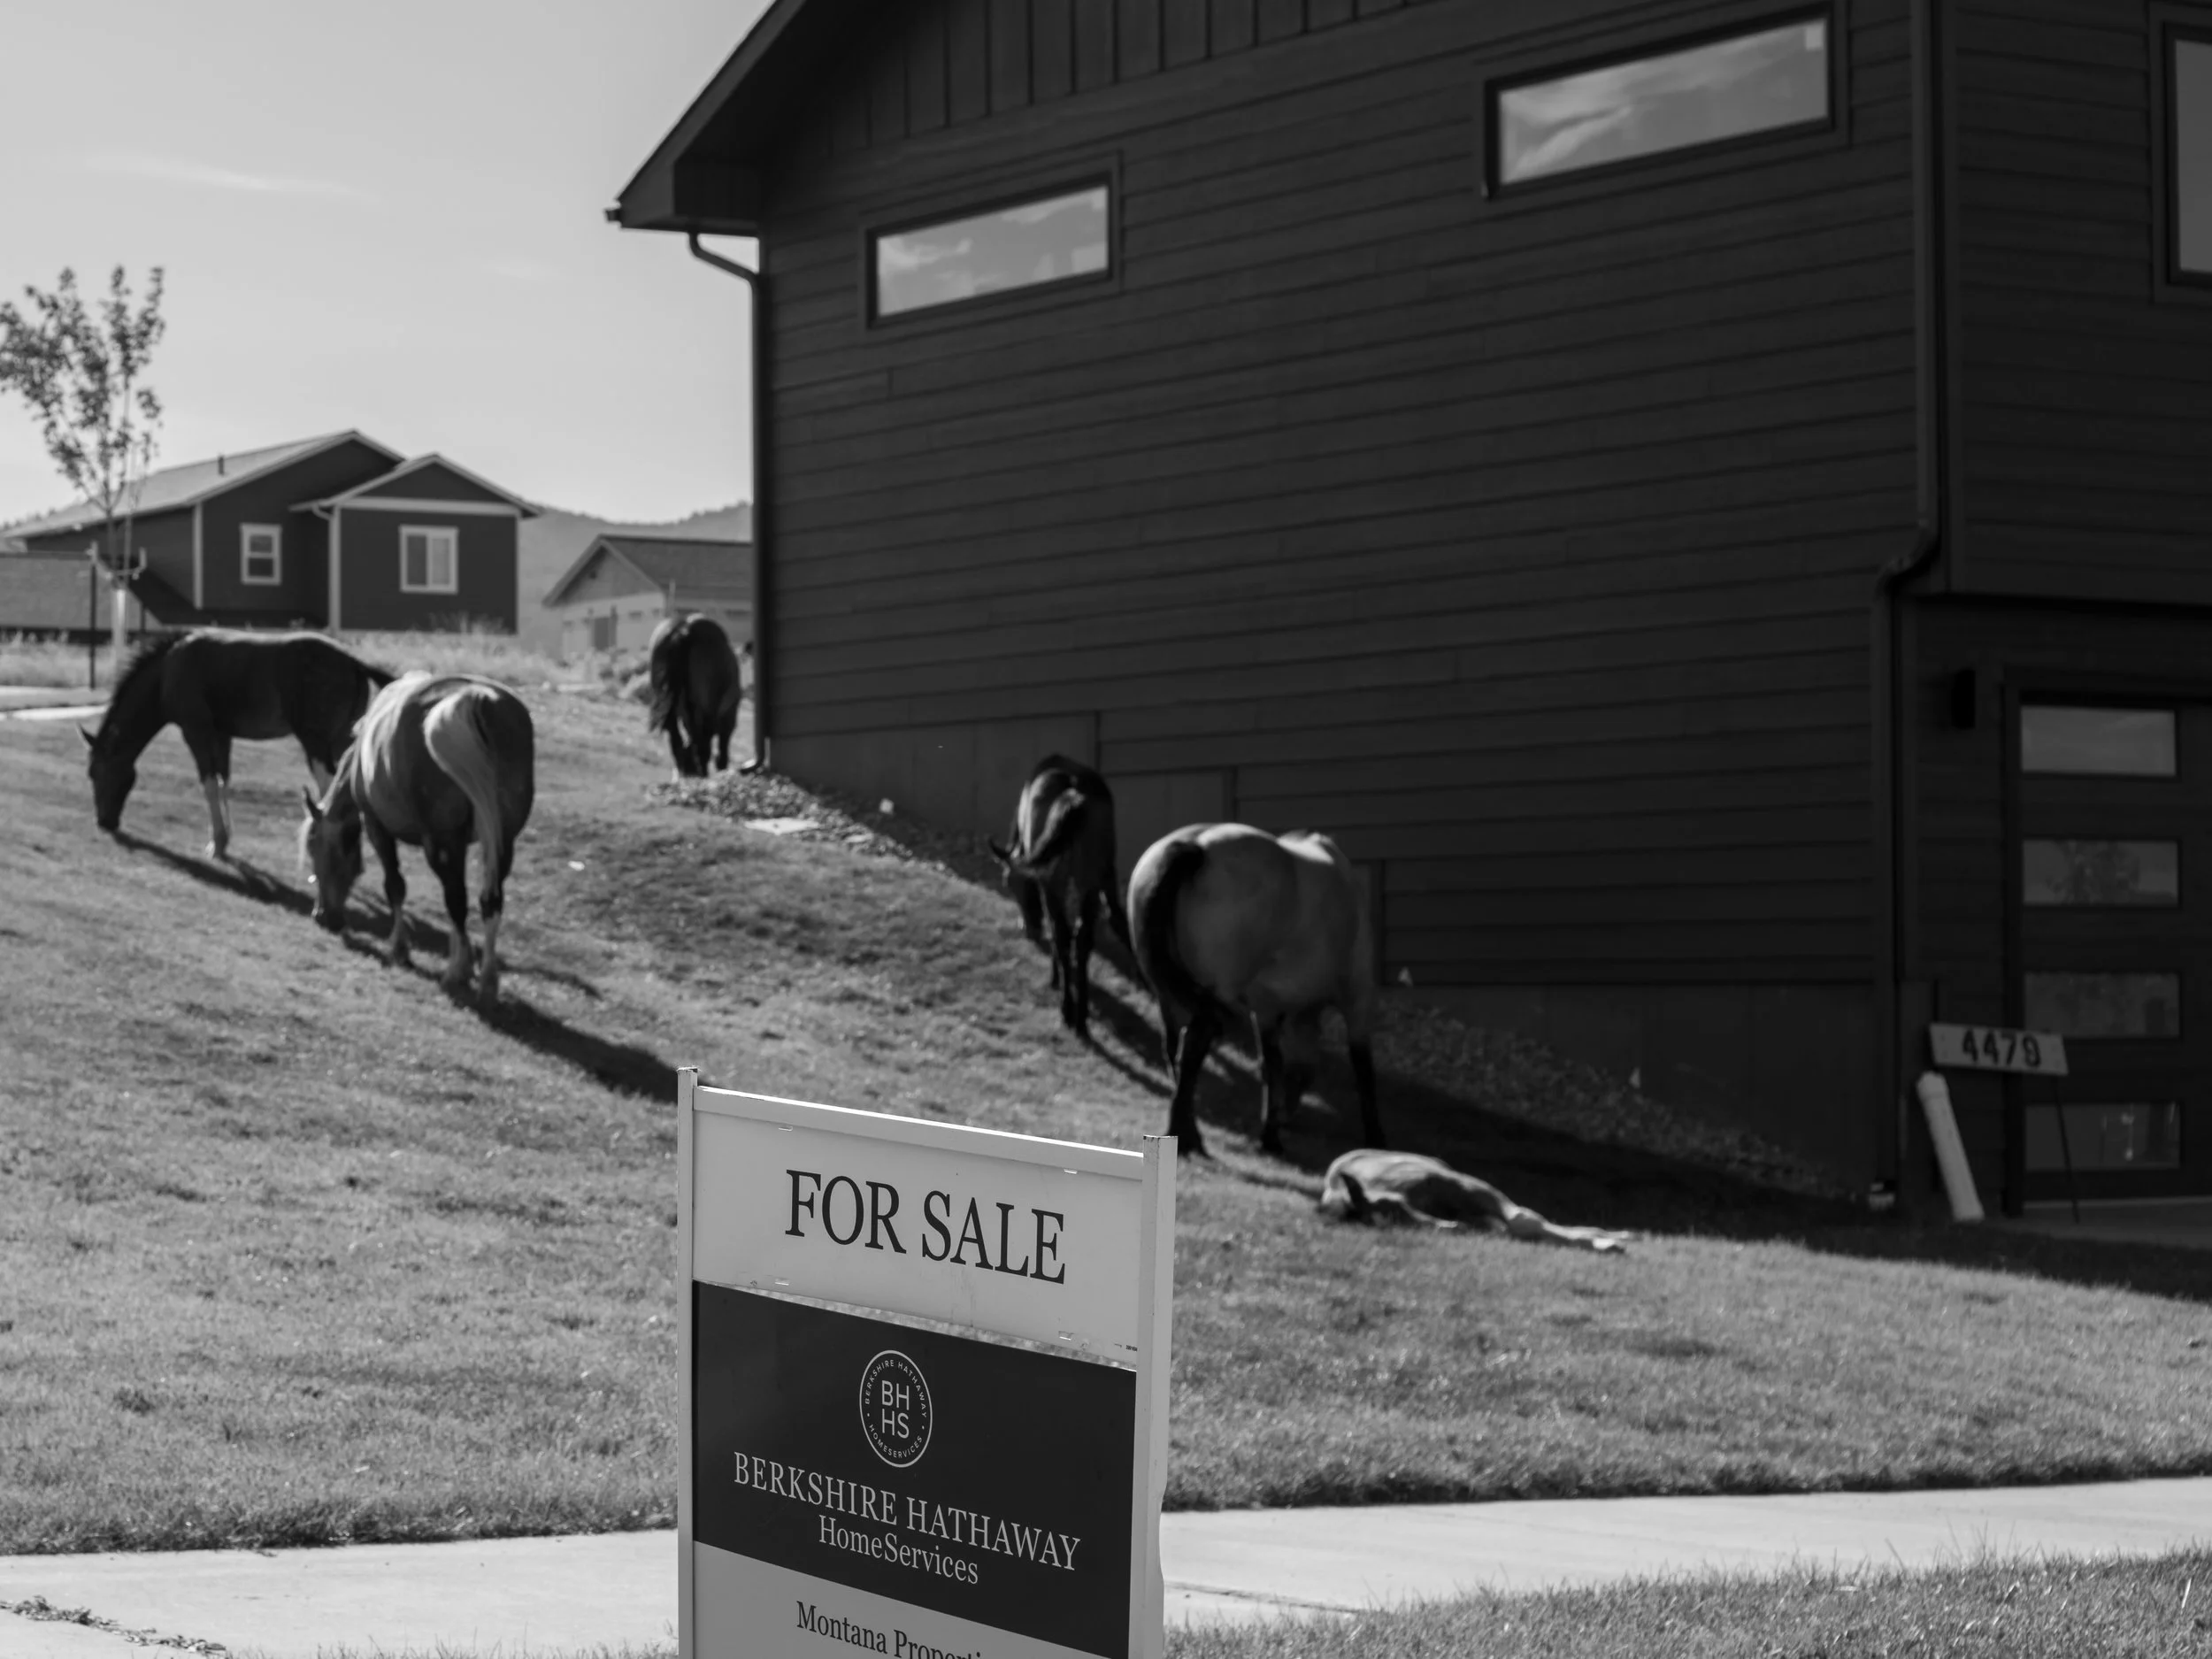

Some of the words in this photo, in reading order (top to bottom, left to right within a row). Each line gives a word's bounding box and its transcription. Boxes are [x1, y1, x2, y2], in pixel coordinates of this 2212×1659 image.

[785, 1169, 907, 1255] FOR
[922, 1190, 1065, 1285] SALE
[864, 1359, 895, 1405] BERKSHIRE
[897, 1361, 927, 1418] HATHAWAY
[881, 1379, 910, 1411] BH
[869, 1424, 923, 1458] HOMESERVICES
[881, 1408, 910, 1439] HS
[733, 1451, 897, 1525] BERKSHIRE
[906, 1496, 1081, 1571] HATHAWAY
[818, 1514, 979, 1585] HomeServices
[796, 1600, 888, 1655] Montana
